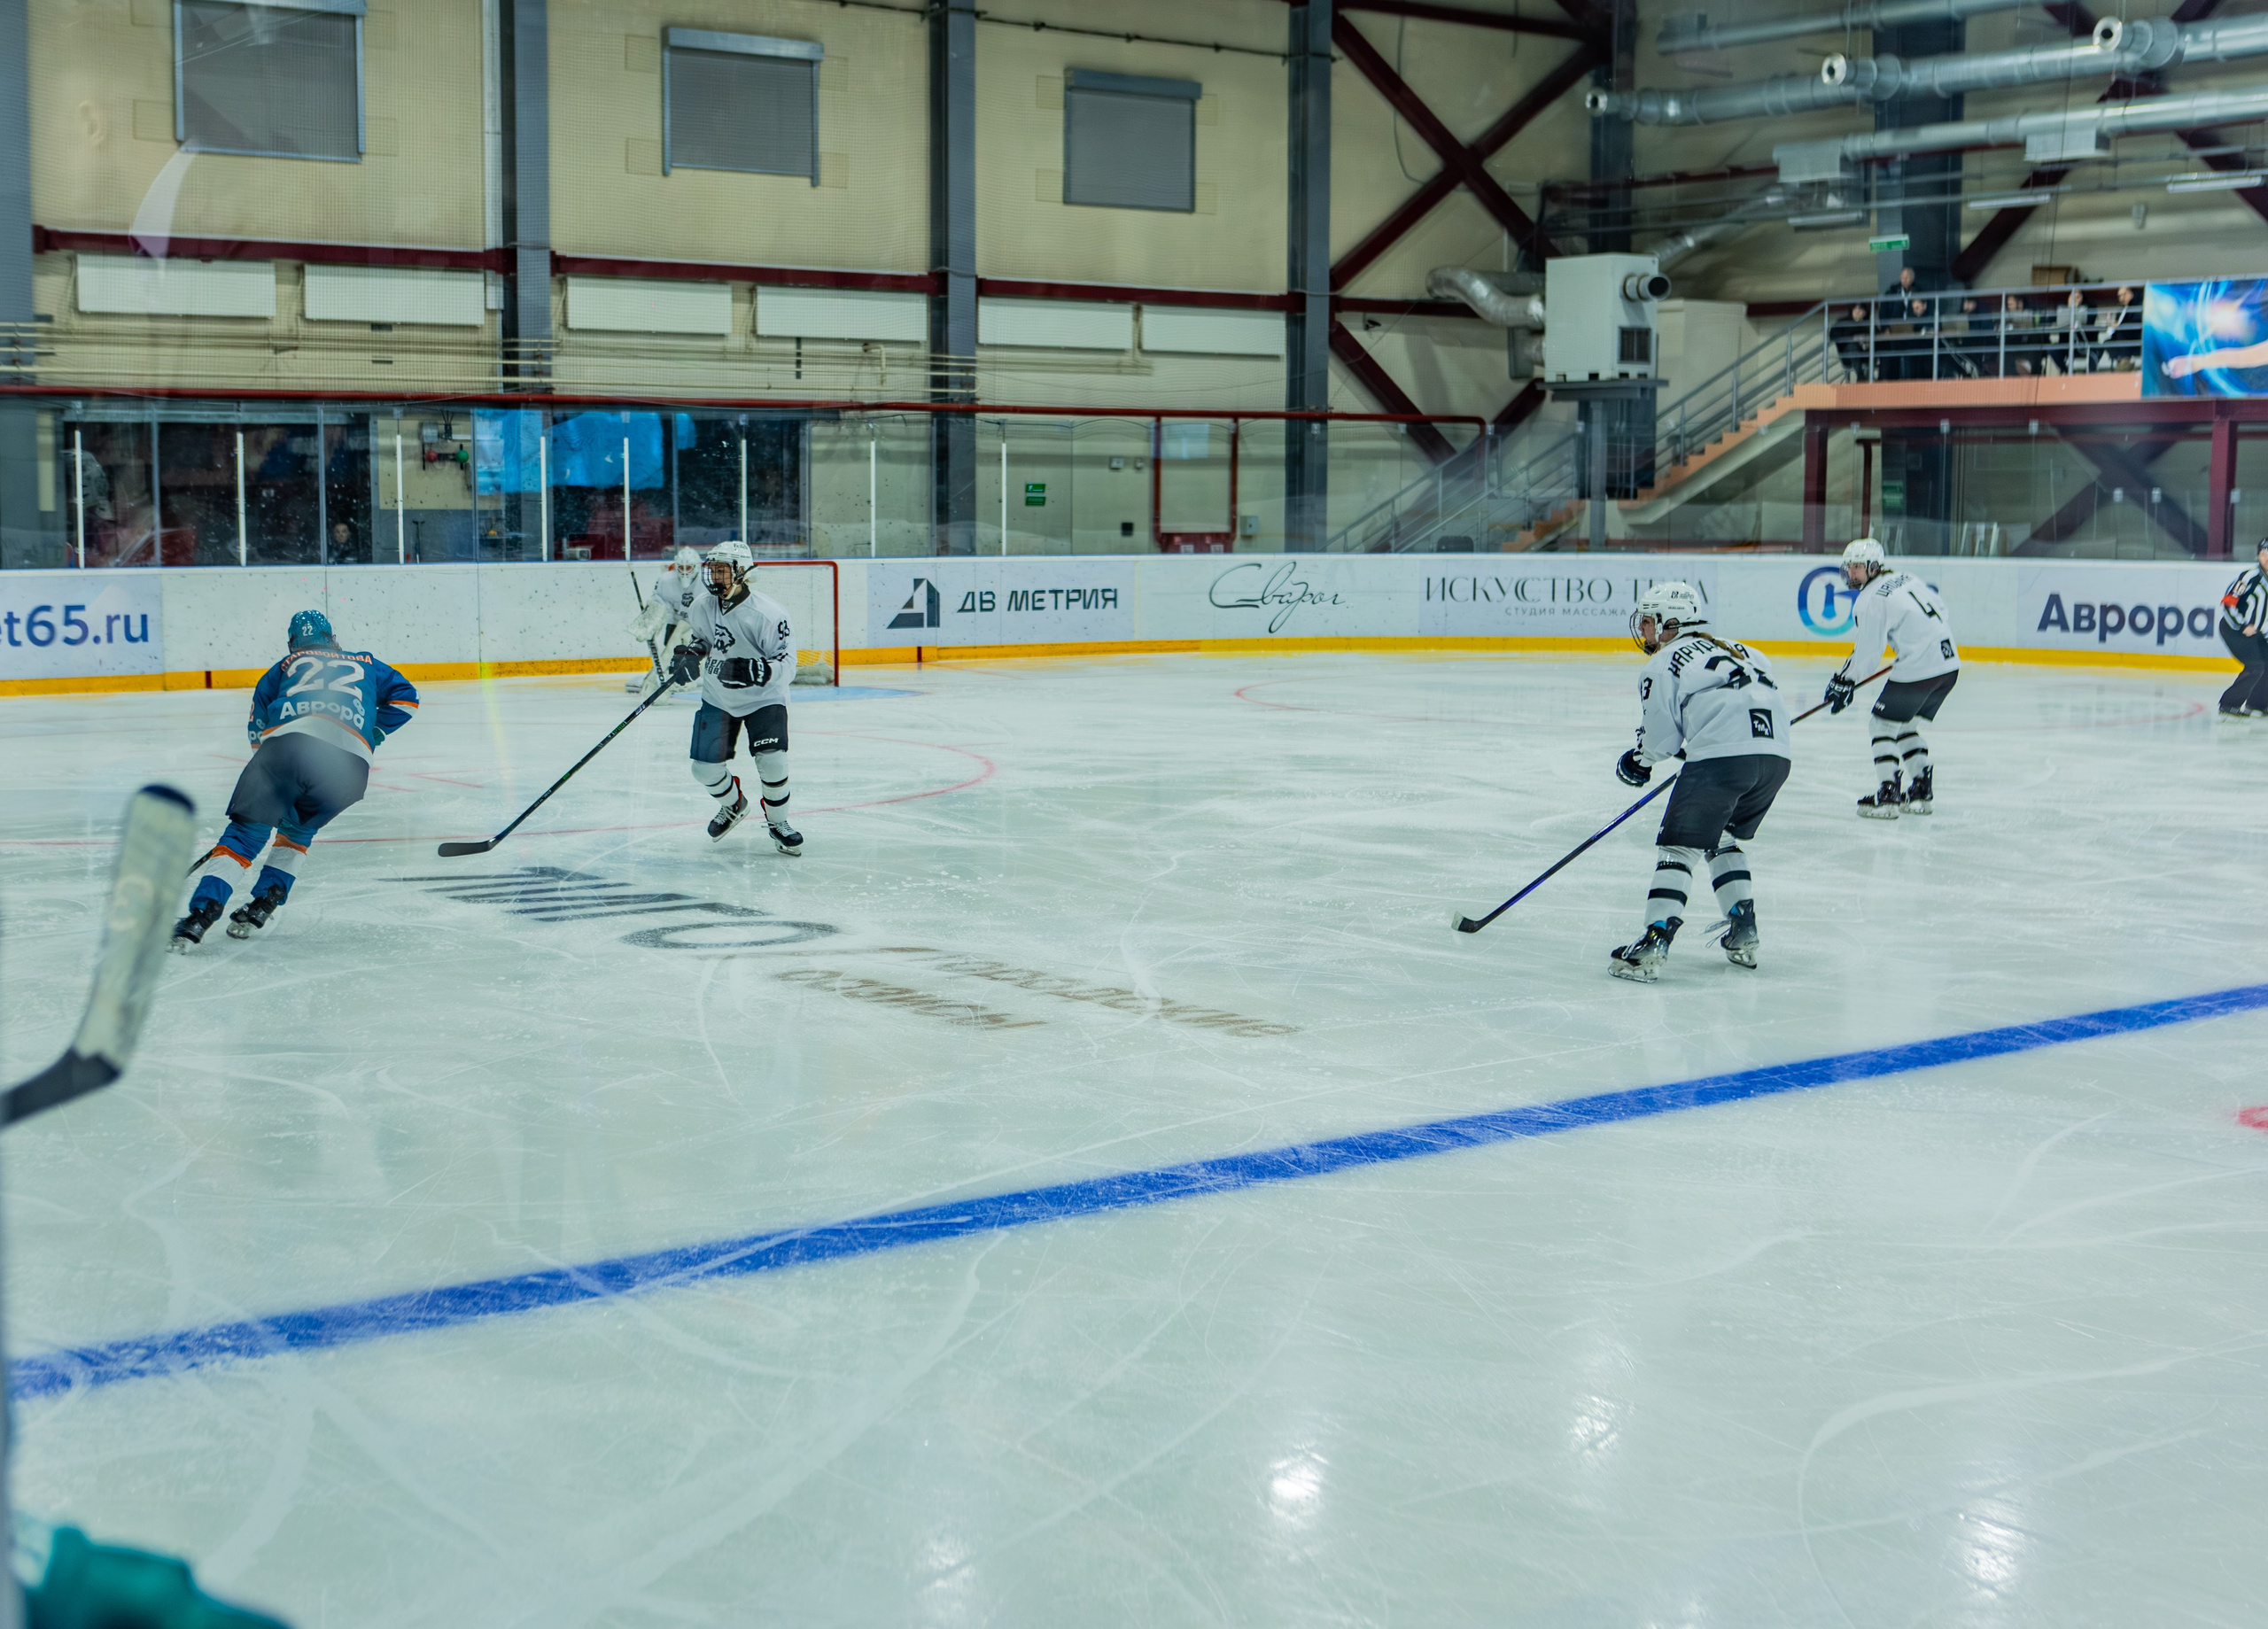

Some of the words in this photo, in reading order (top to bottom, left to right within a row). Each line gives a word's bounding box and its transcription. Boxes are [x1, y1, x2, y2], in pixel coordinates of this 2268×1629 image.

[957, 591, 996, 613] ДВ
[1007, 588, 1118, 611] МЕТРИЯ
[1626, 578, 1708, 604] ТА
[1505, 607, 1556, 617] СТУДИЯ
[1562, 607, 1627, 617] МАССАЖА
[2037, 593, 2215, 646] Аврора
[0, 605, 149, 647] t65.ru
[301, 625, 314, 637] 22
[286, 656, 365, 702] 22
[279, 701, 365, 730] Аврора
[753, 737, 779, 747] CCM
